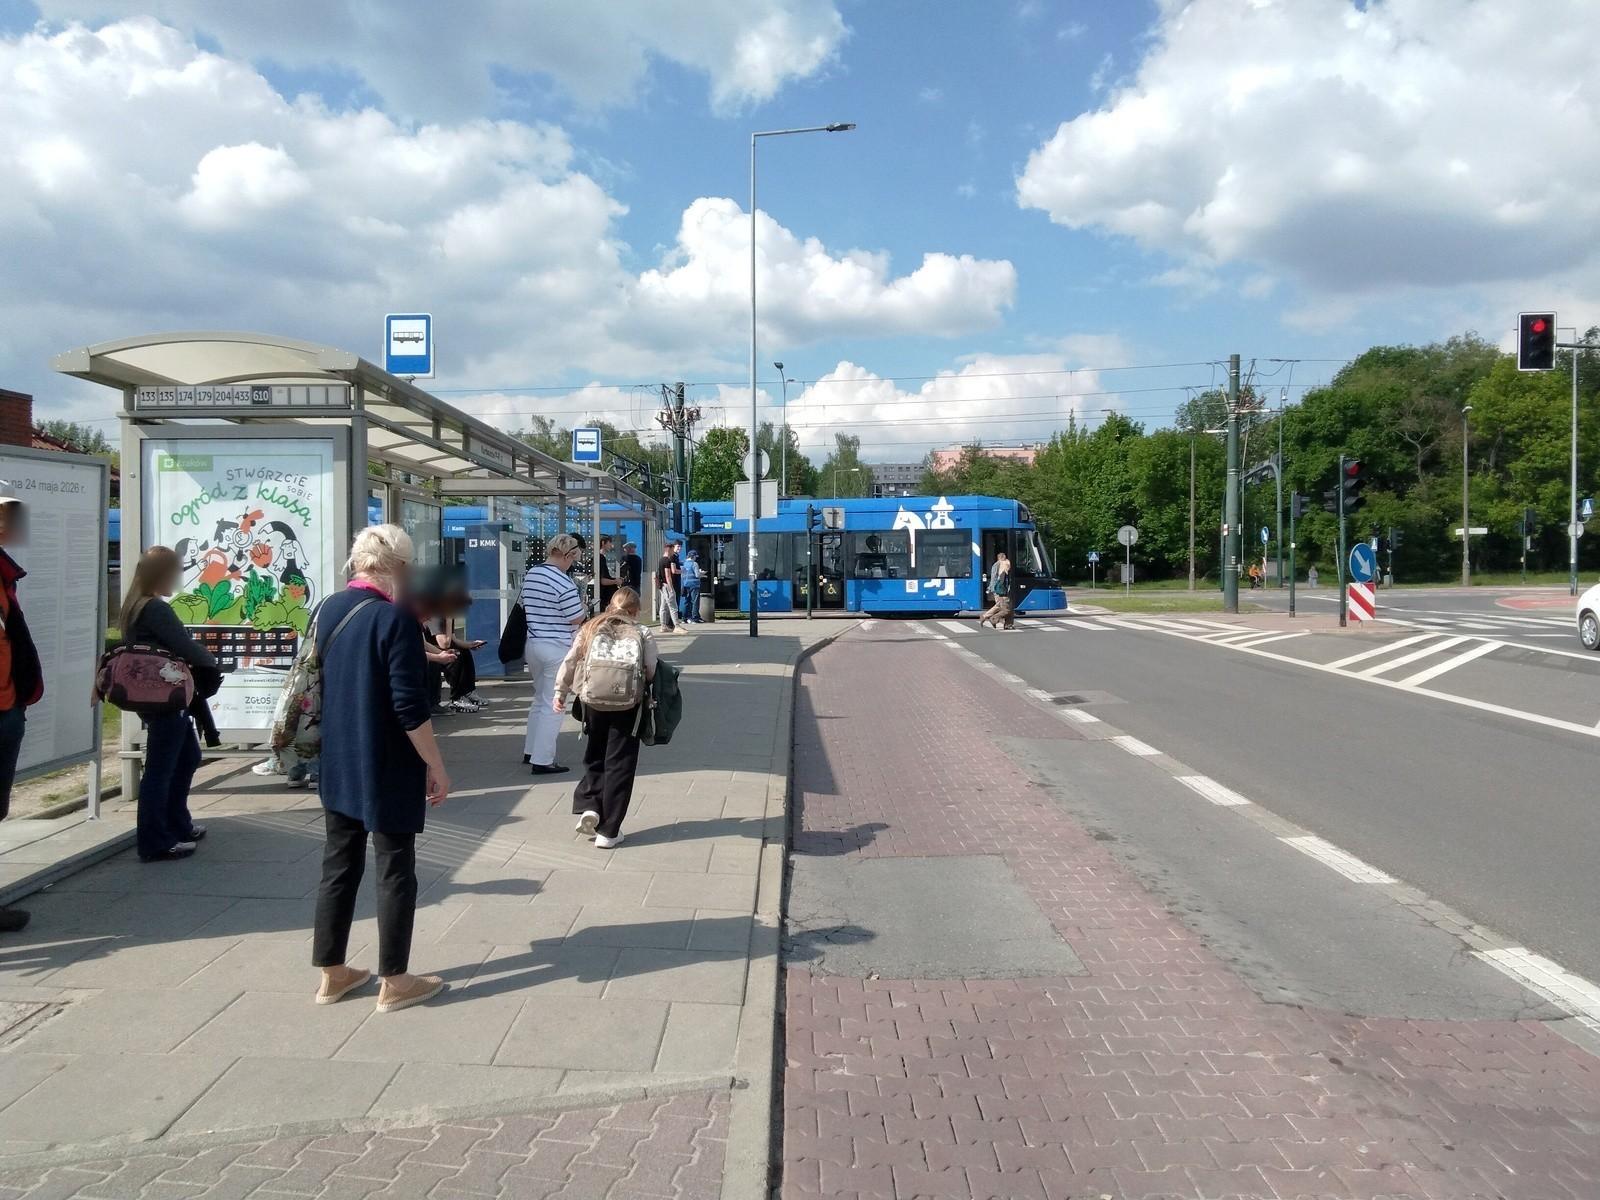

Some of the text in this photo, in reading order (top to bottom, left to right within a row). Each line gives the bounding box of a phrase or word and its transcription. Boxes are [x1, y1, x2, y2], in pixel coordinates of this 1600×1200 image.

[141, 390, 269, 401] 133 135 174 179 204 433 610
[11, 480, 23, 489] na
[25, 478, 36, 490] 24
[38, 481, 59, 494] maja
[60, 481, 80, 494] 2026
[287, 485, 313, 501] SOBIE
[171, 481, 228, 526] ogród
[256, 481, 314, 527] klasą
[480, 539, 497, 547] KMK
[245, 693, 271, 705] ZGŁOŚ
